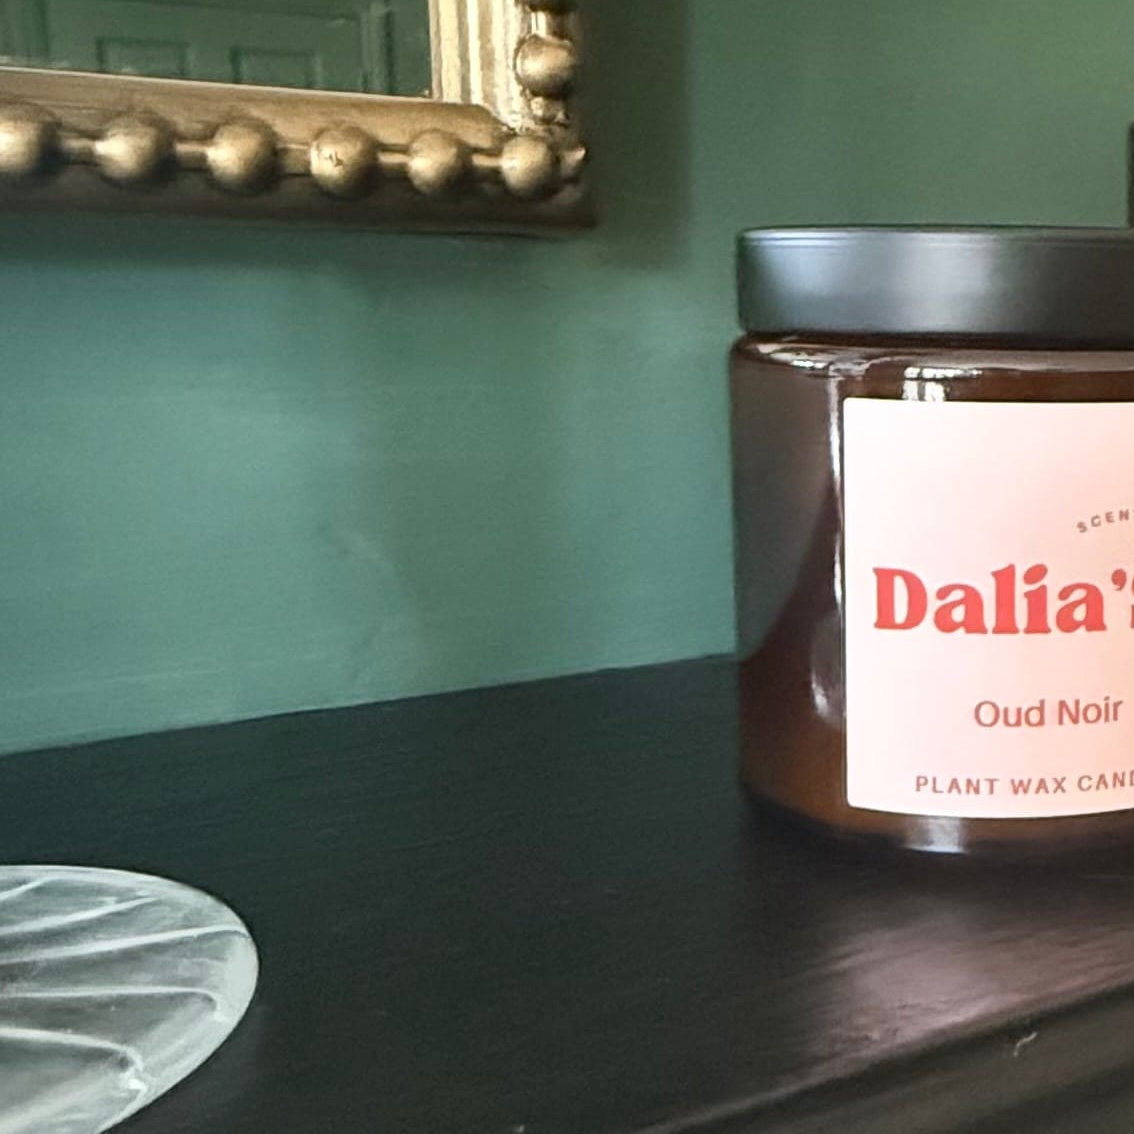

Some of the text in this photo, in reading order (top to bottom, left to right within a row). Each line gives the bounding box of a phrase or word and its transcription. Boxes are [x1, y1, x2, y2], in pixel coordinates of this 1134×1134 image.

[973, 696, 1124, 728] Oud Noir
[915, 774, 1000, 796] PLANT
[1010, 776, 1067, 796] WAX
